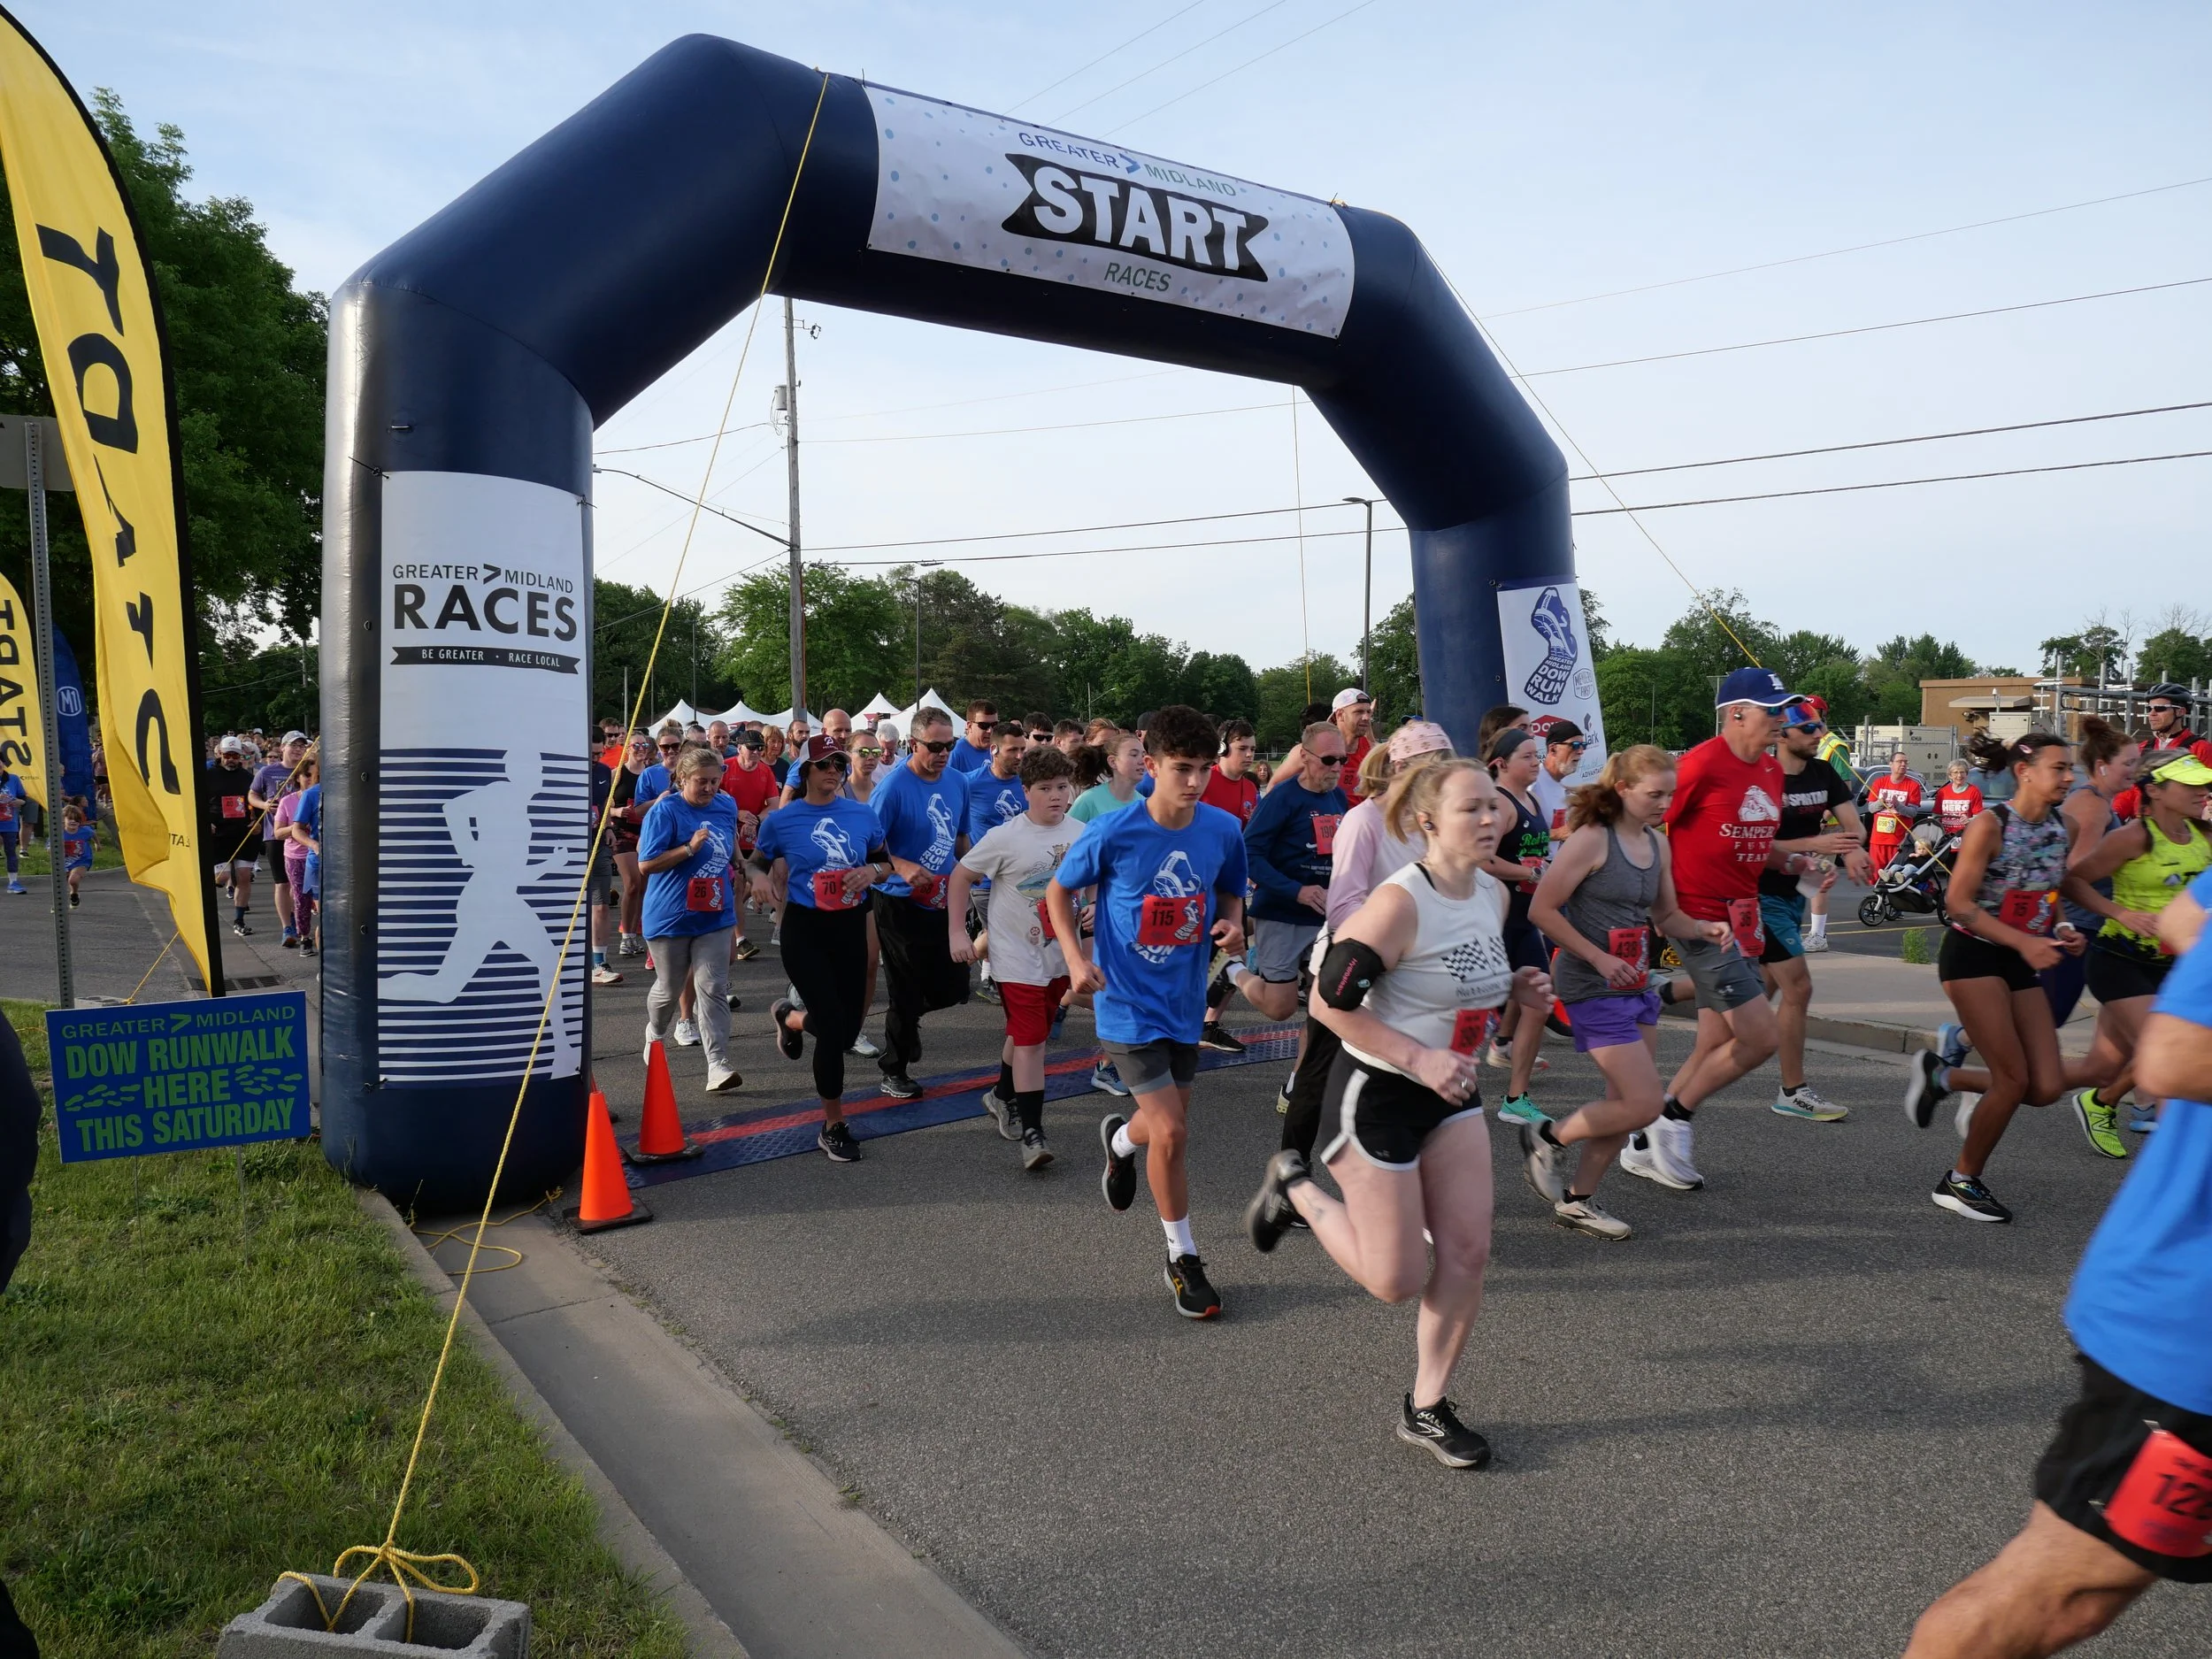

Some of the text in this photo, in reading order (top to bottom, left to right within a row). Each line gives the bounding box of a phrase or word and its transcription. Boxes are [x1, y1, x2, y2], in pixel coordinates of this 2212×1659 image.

[1018, 131, 1237, 197] GREATER MIDLAND
[1033, 165, 1247, 271] START
[1104, 262, 1171, 292] RACES
[393, 564, 573, 594] GREATER MIDLAND
[394, 583, 578, 641] RACES
[421, 649, 560, 667] BE GREATER RACE LOCAL
[1544, 659, 1571, 671] MIDLAND
[1538, 664, 1569, 681] DOW
[1531, 673, 1564, 693] RUN
[1526, 684, 1560, 703] WALK
[1343, 774, 1355, 785] 82
[1942, 803, 1971, 812] HERO
[1320, 825, 1335, 839] 190
[1719, 823, 1776, 838] SEMPER
[922, 850, 946, 865] RUN
[928, 844, 950, 857] DOW
[702, 863, 724, 873] DOW
[694, 886, 707, 898] 26
[822, 881, 836, 895] 70
[1151, 909, 1175, 926] 115
[61, 1006, 296, 1040] GREATER MIDLAND
[65, 1025, 296, 1079] DOW RUNWALK
[143, 1069, 231, 1109] HERE
[1793, 1097, 1815, 1111] HOKA
[76, 1097, 295, 1152] THIS SATURDAY
